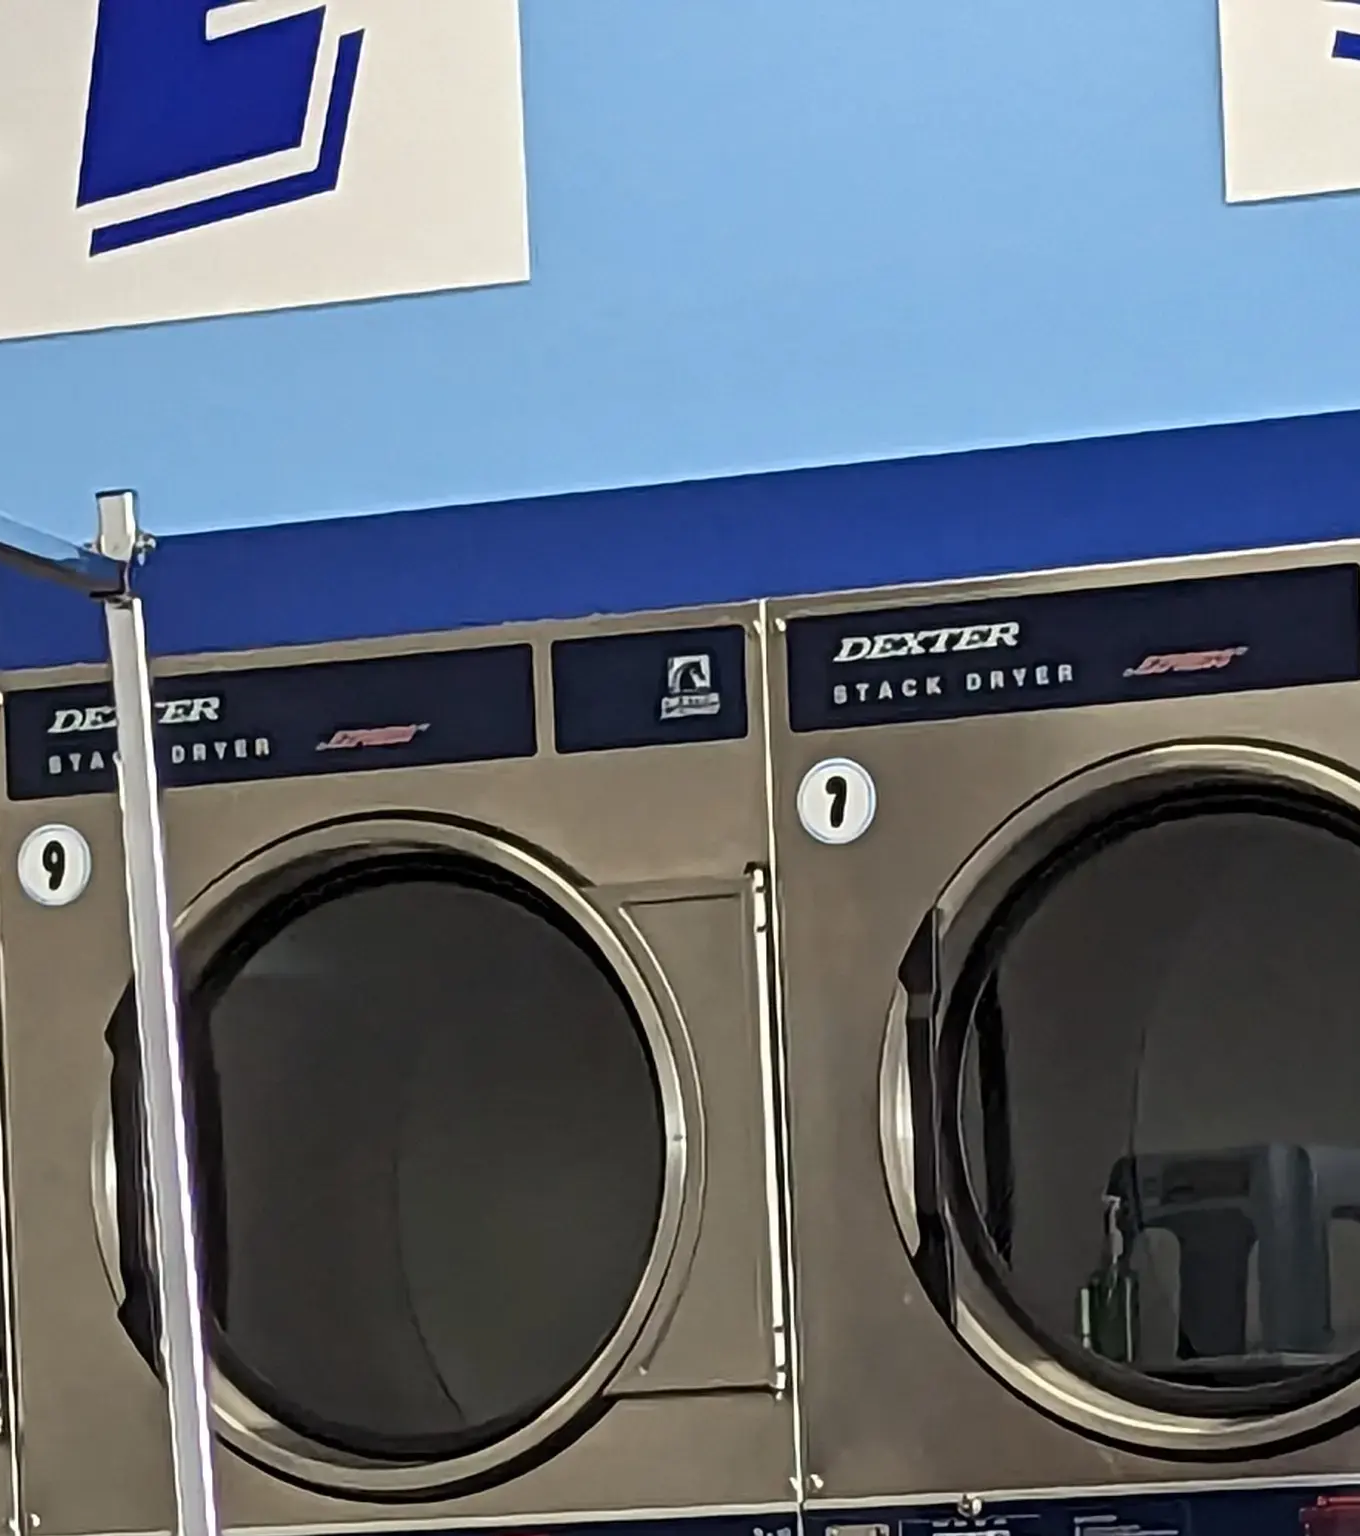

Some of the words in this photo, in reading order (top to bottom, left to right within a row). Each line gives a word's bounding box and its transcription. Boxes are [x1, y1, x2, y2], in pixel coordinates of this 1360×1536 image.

[833, 621, 1020, 662] DEXTER
[833, 675, 942, 704] STACK
[966, 664, 1073, 691] DRYER
[47, 697, 220, 733] DEER
[171, 738, 270, 764] DRYER
[824, 774, 848, 829] 7
[42, 839, 67, 891] 9
